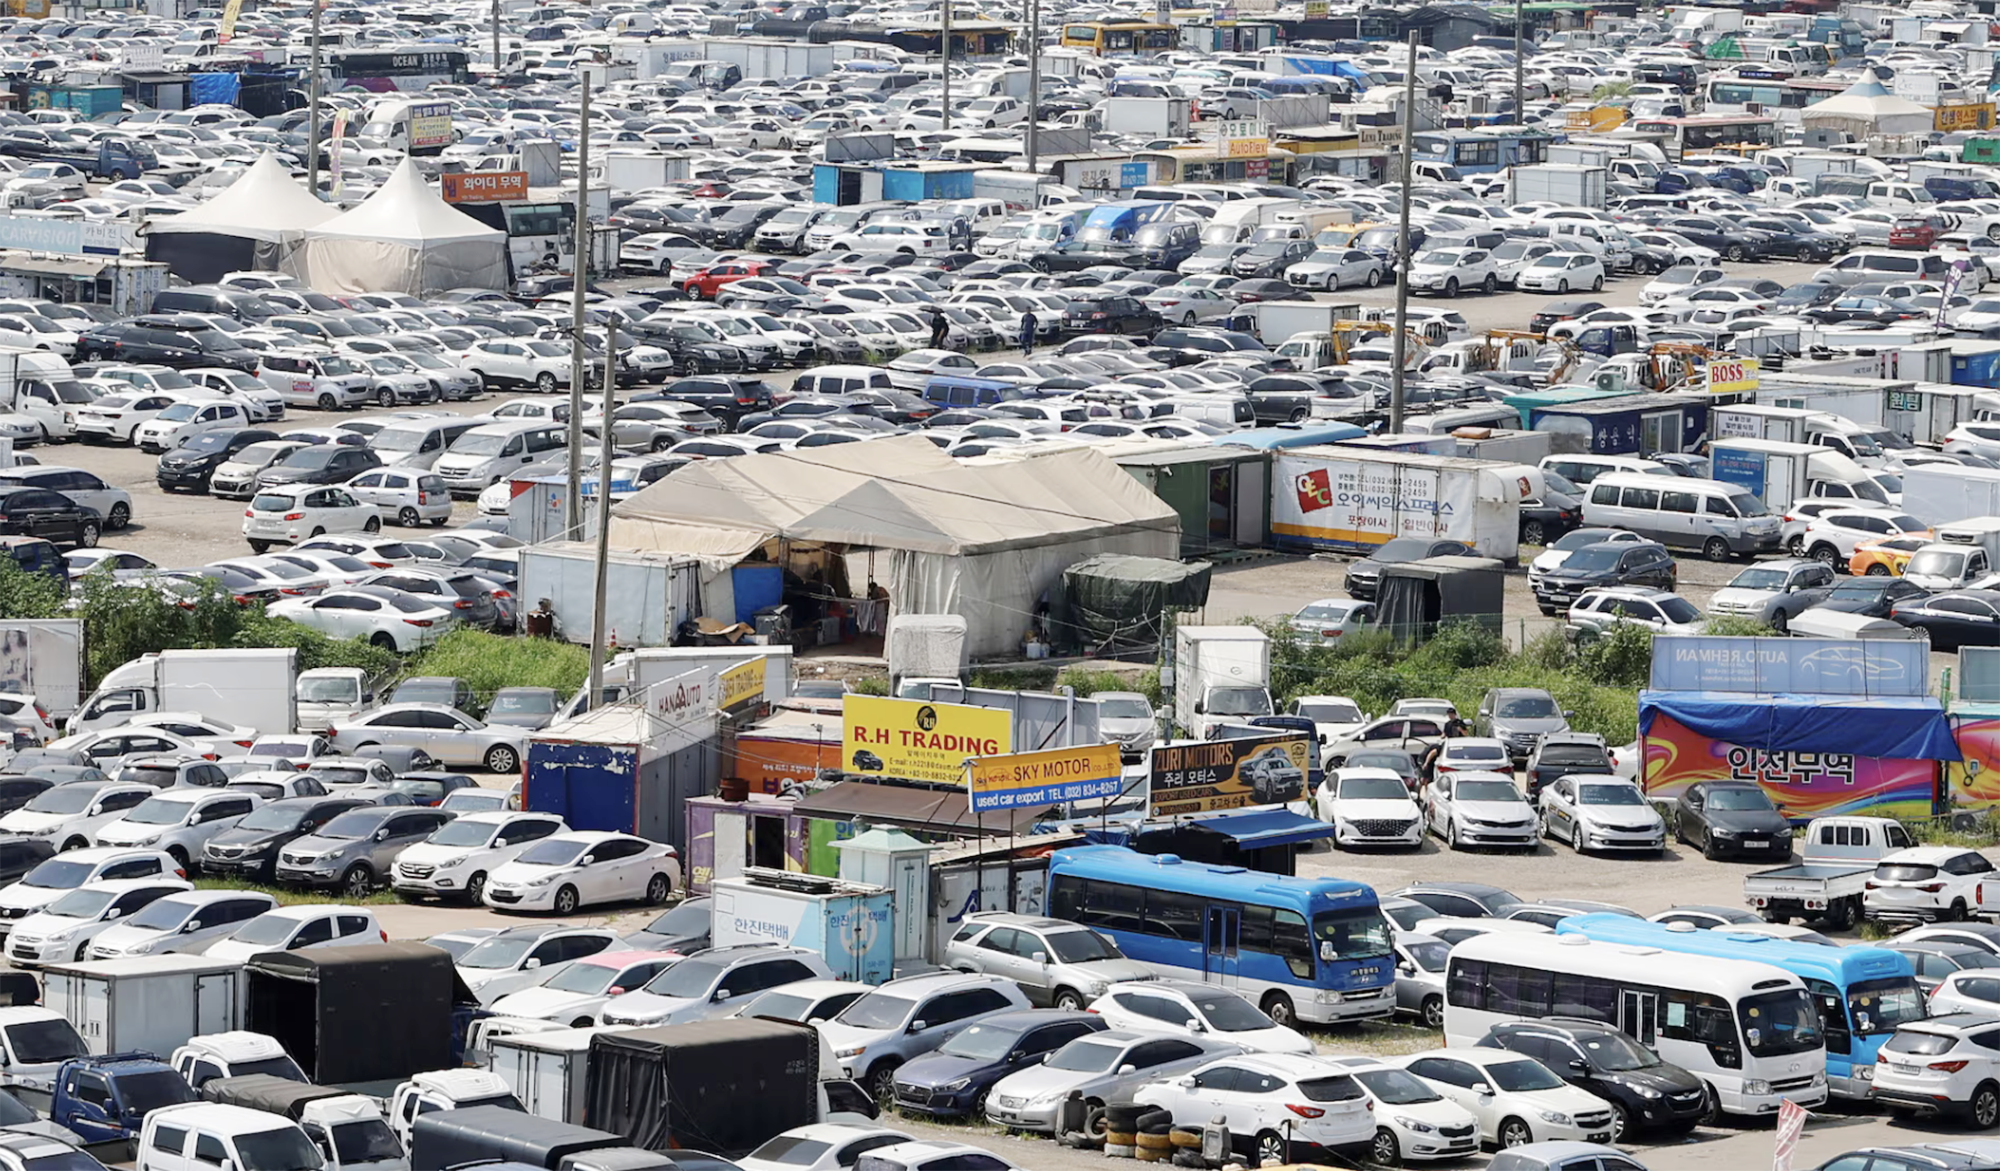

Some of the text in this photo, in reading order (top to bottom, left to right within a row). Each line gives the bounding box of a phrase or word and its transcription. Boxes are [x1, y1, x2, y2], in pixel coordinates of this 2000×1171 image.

[393, 55, 418, 67] OCEAN
[464, 175, 522, 190] 와이디 무역
[85, 227, 117, 239] 카비전
[1711, 364, 1743, 383] BOSS
[1348, 515, 1387, 527] 포장이사
[923, 717, 935, 729] RH
[854, 726, 998, 755] R.H TRADING
[1155, 743, 1233, 772] ZURI MOTORS
[1727, 747, 1855, 784] 인천무역
[1014, 764, 1039, 781] SKY
[1043, 758, 1090, 778] MOTOR
[1164, 769, 1217, 787] 주리 모터스
[977, 794, 998, 807] used
[1000, 795, 1014, 807] car
[1016, 789, 1044, 804] export
[1083, 780, 1118, 796] 834-8267
[1155, 791, 1178, 802] EXPORT
[830, 910, 888, 928] 한진 택배
[734, 917, 789, 940] 한진택배
